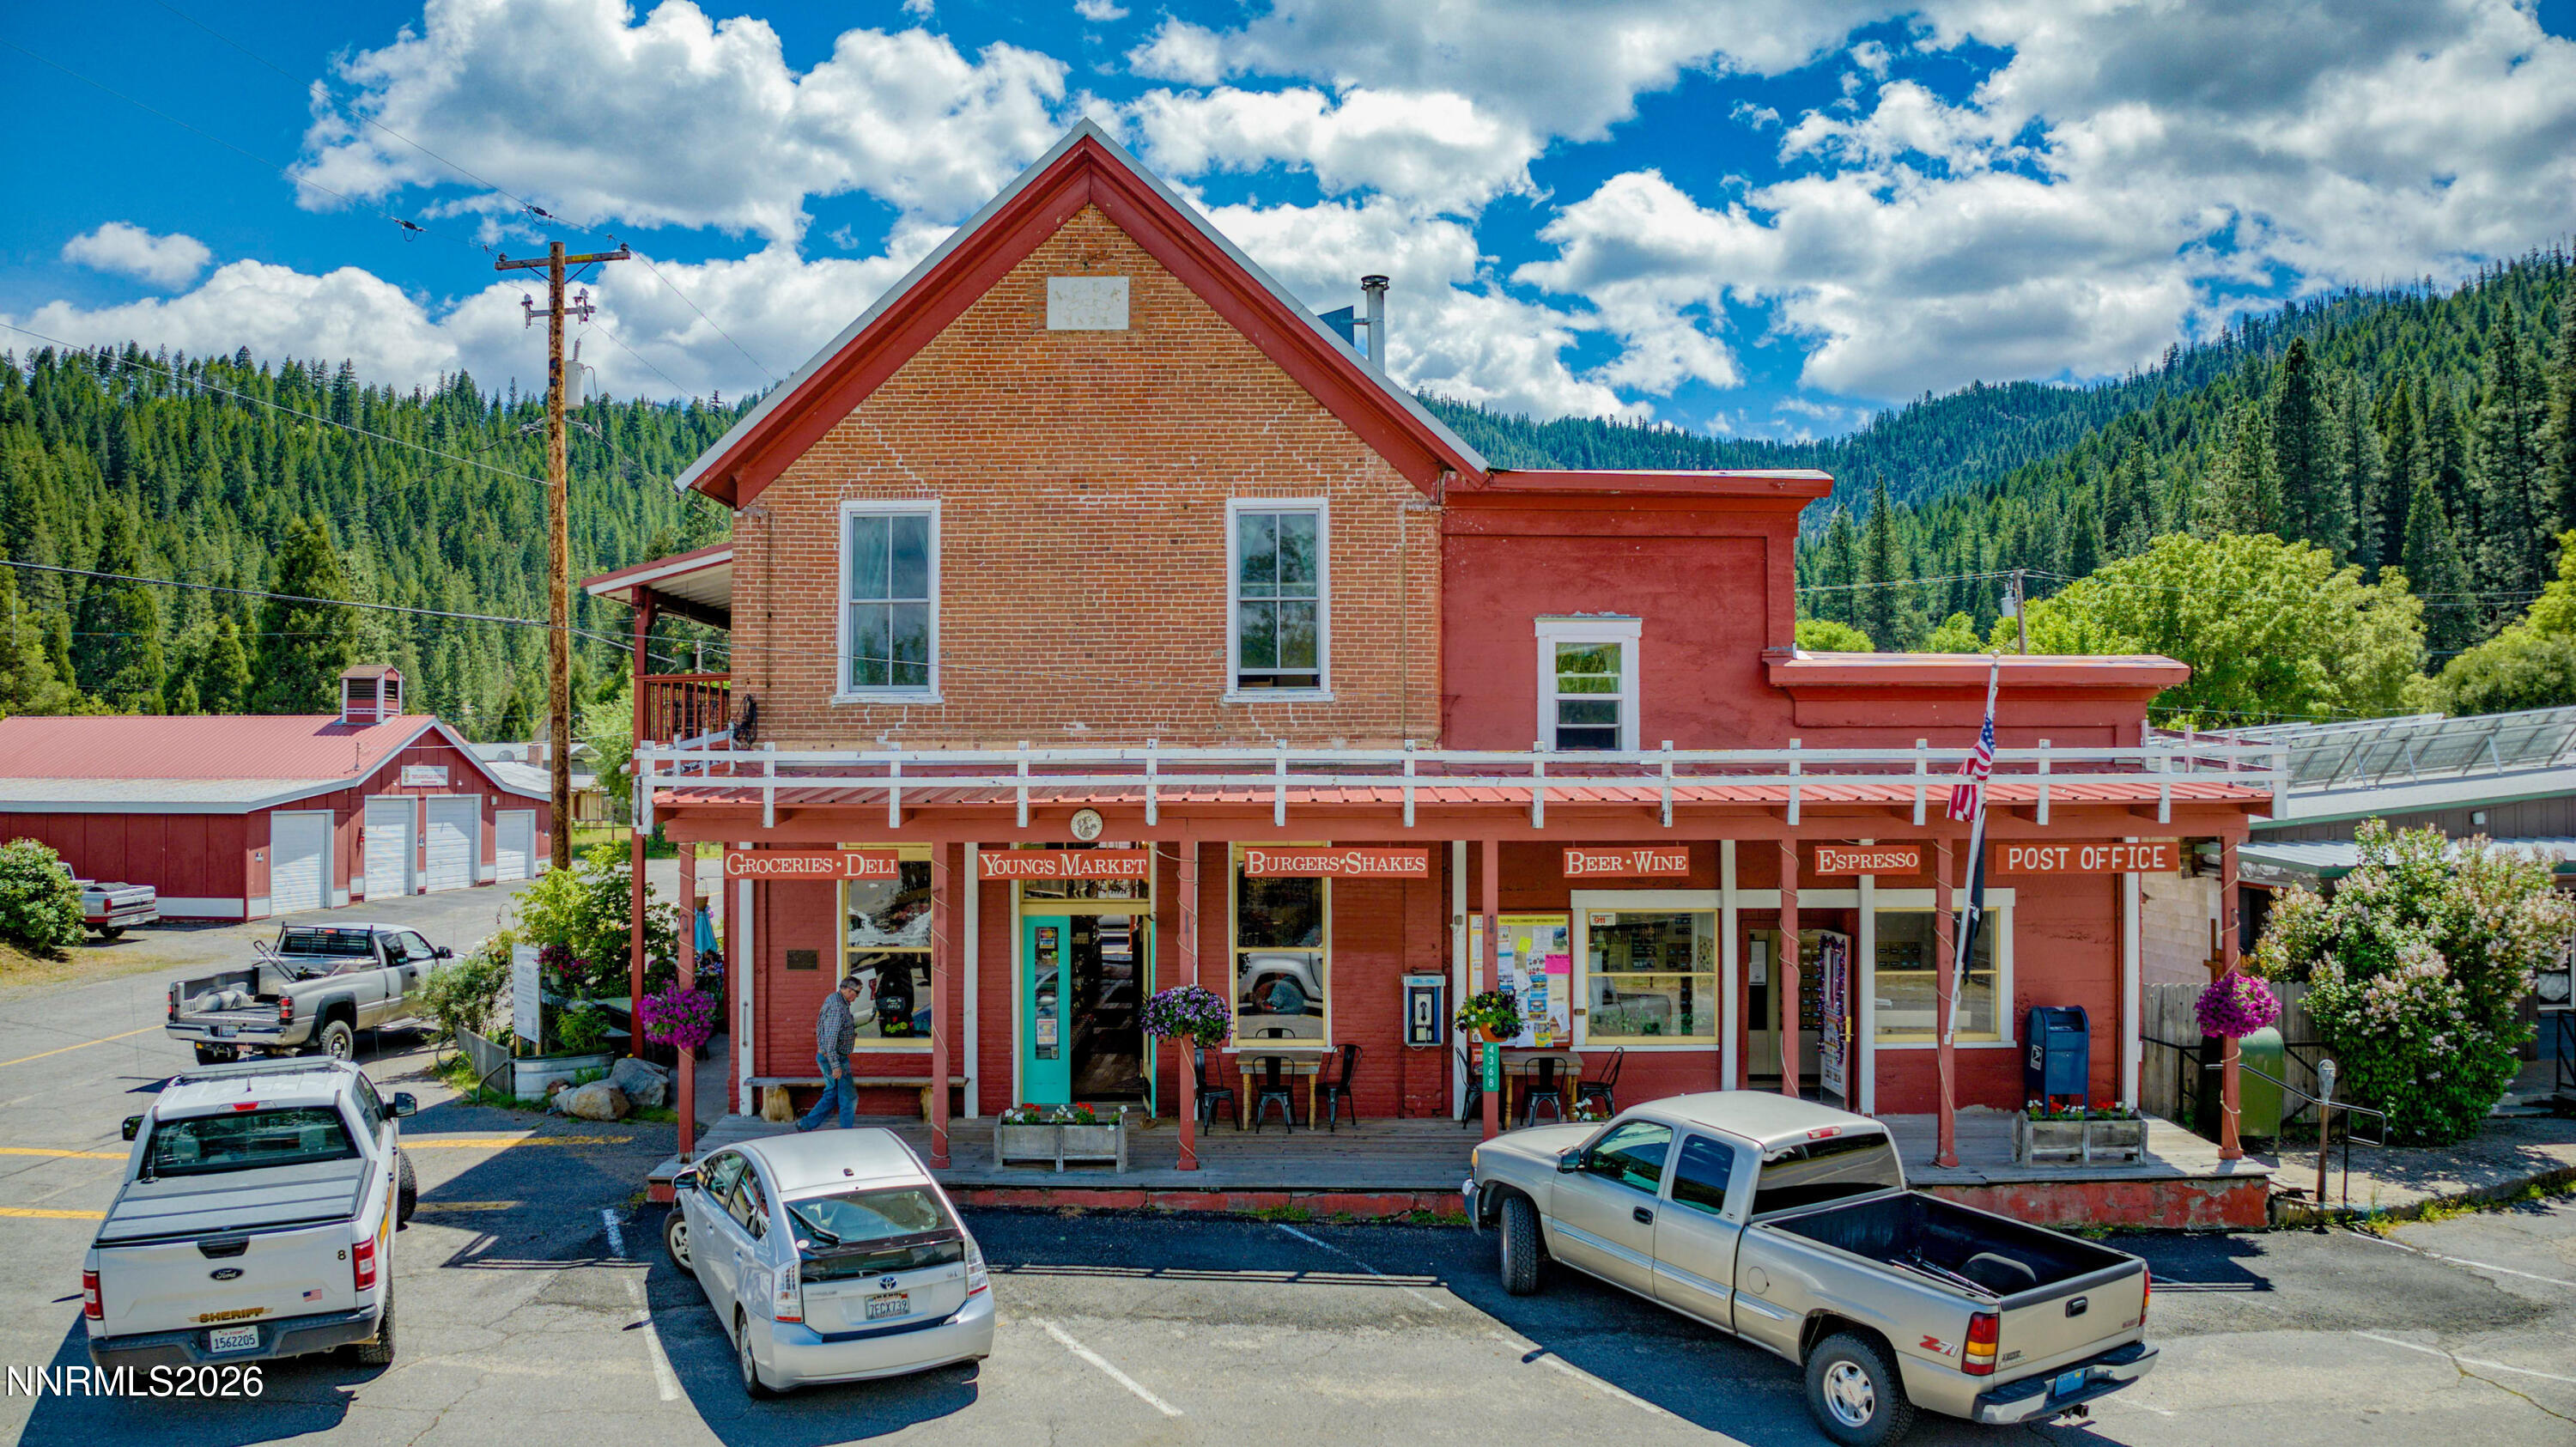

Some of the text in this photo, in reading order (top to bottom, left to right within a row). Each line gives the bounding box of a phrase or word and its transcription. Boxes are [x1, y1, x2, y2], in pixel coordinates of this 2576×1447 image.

[726, 853, 896, 877] GROCERIES DELI
[980, 854, 1147, 877] YOUNG'S MARKET
[1565, 850, 1686, 874] BEER WINE
[1816, 849, 1918, 872] ESPRESSO
[2008, 846, 2166, 870] POST OFFICE
[337, 1249, 347, 1261] 8
[216, 1269, 239, 1280] Ford
[199, 1306, 265, 1323] SHERIFF
[215, 1334, 256, 1349] 1562205
[1919, 1335, 1959, 1358] Z71
